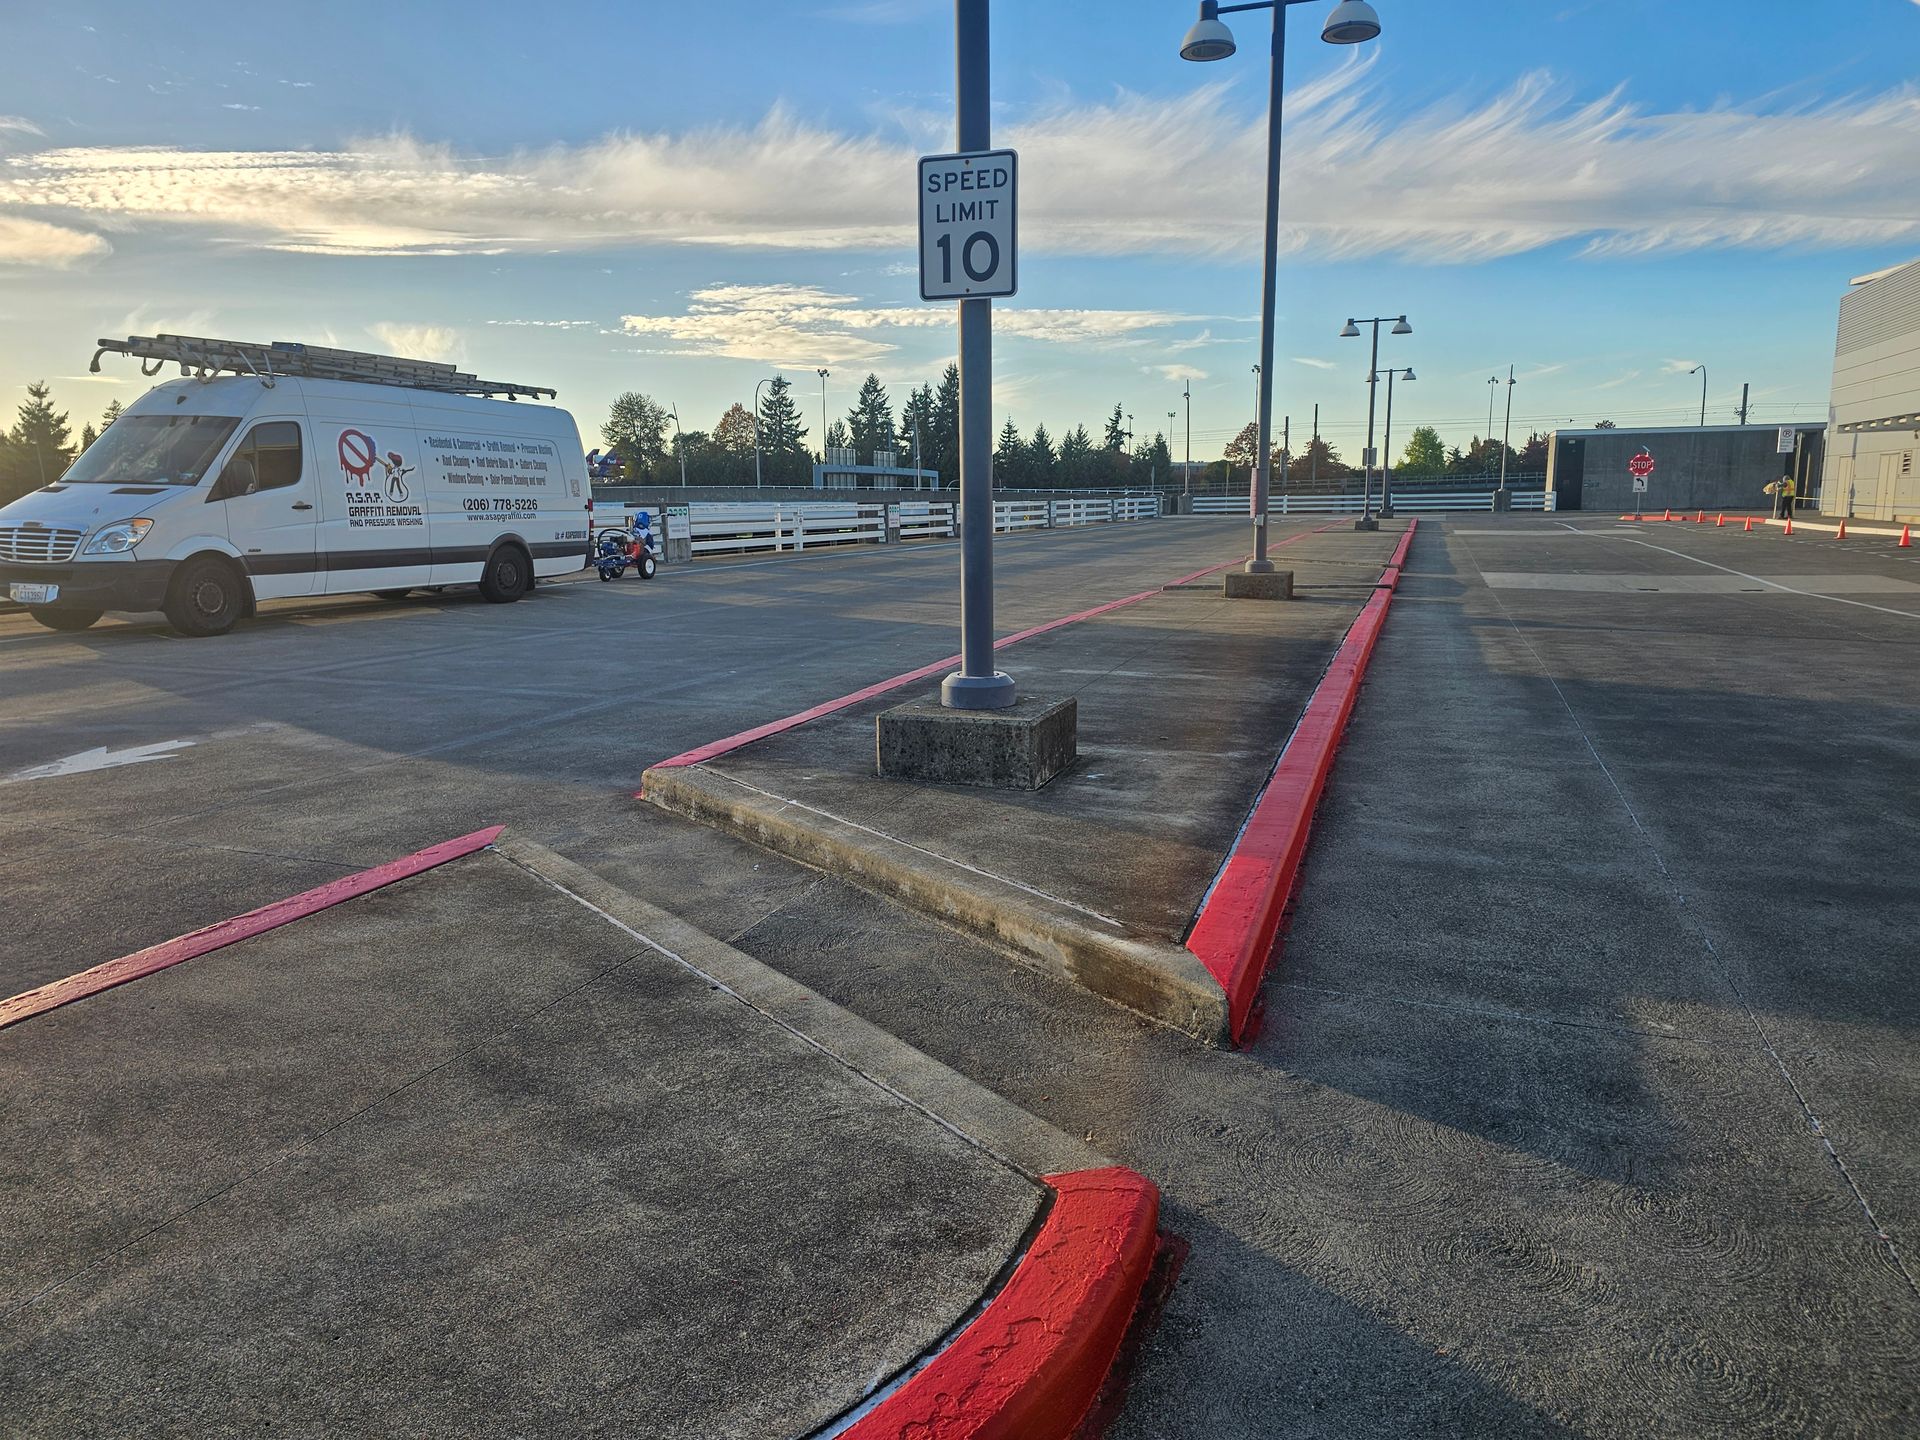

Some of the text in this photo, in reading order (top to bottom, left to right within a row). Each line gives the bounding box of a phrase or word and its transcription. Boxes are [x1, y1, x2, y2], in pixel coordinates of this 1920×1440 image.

[928, 168, 1008, 193] SPEED
[936, 200, 999, 223] LIMIT
[937, 231, 1000, 283] 10
[429, 436, 452, 449] Residential
[457, 438, 481, 450] Commercial
[1632, 461, 1652, 469] STOP
[463, 498, 538, 511] (206) 778-5226
[349, 506, 422, 517] GRAFFITI REMOVAL
[466, 512, 537, 522] www.asapgraffiti.com
[350, 518, 423, 527] AND PRESSURE WASHING
